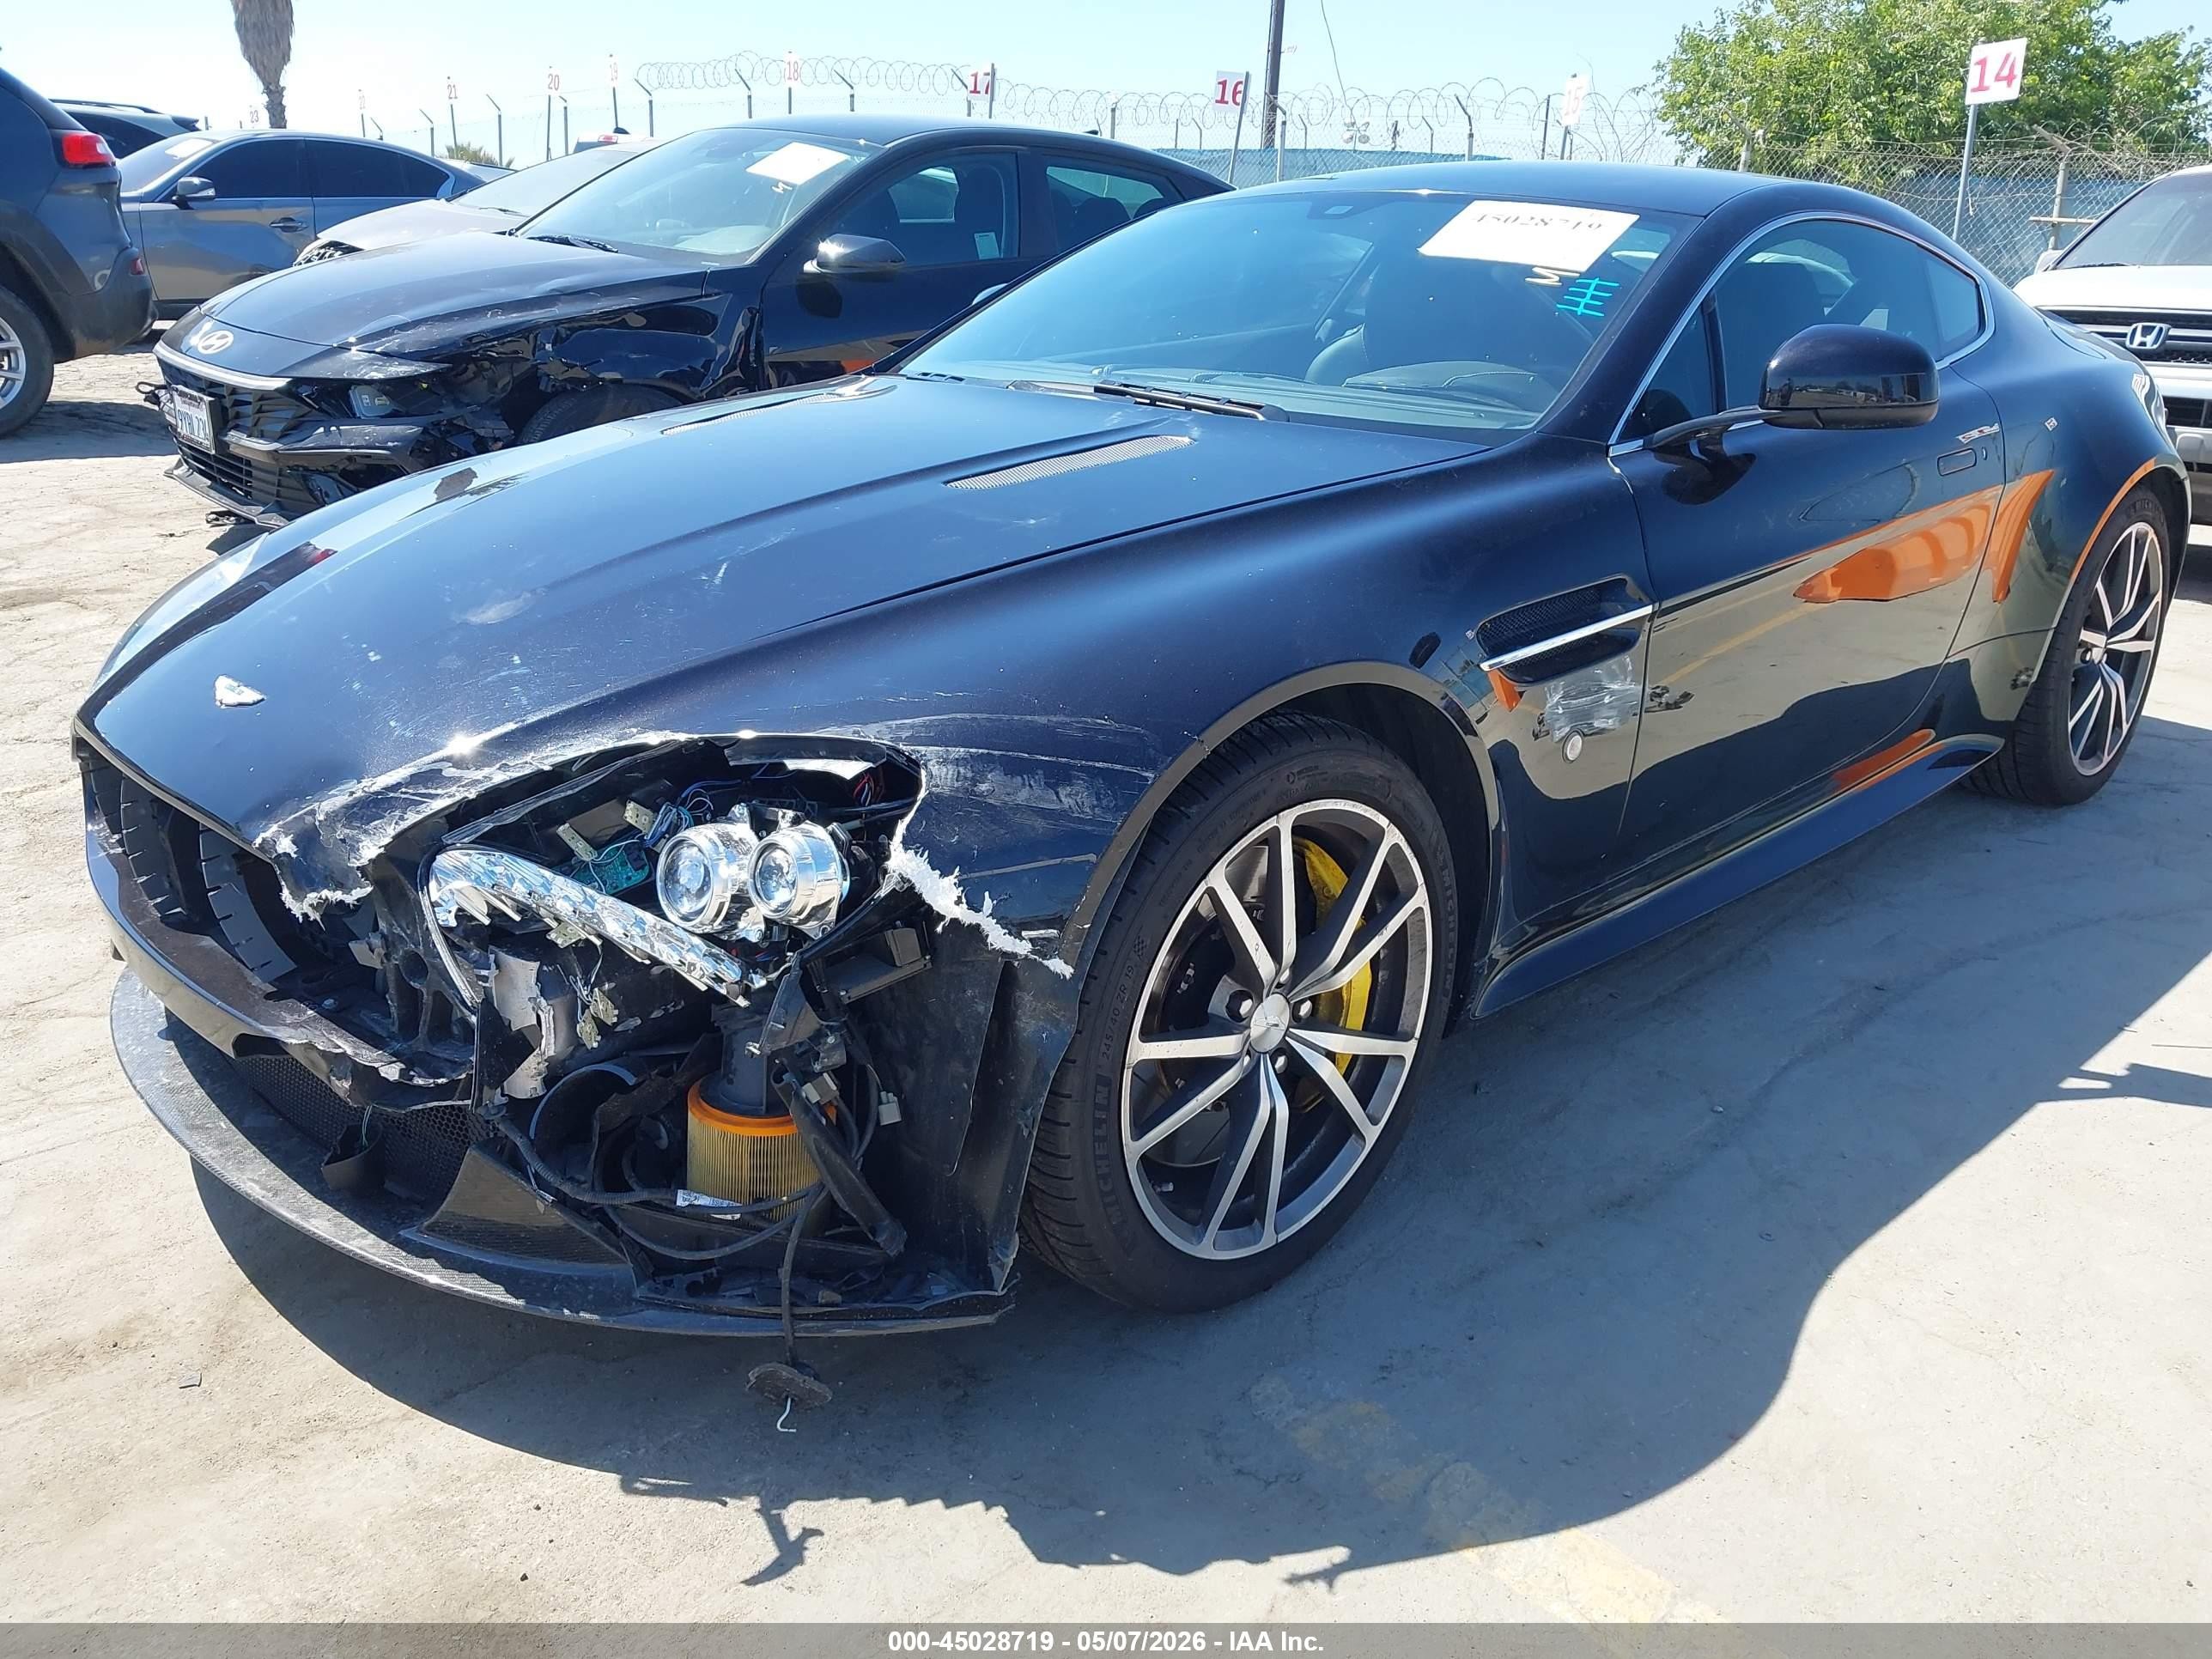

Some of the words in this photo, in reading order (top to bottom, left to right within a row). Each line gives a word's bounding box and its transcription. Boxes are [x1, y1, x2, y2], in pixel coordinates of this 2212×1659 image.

[548, 73, 560, 91] 20
[787, 60, 799, 82] 18
[969, 70, 991, 94] 17
[1970, 52, 2017, 93] 14
[447, 83, 459, 100] 21
[1215, 79, 1244, 106] 16
[249, 109, 259, 124] 23
[1103, 1008, 1121, 1060] 245/40
[1117, 984, 1127, 1003] ZR
[1126, 964, 1135, 980] 19
[1093, 1082, 1127, 1224] MICHELIN
